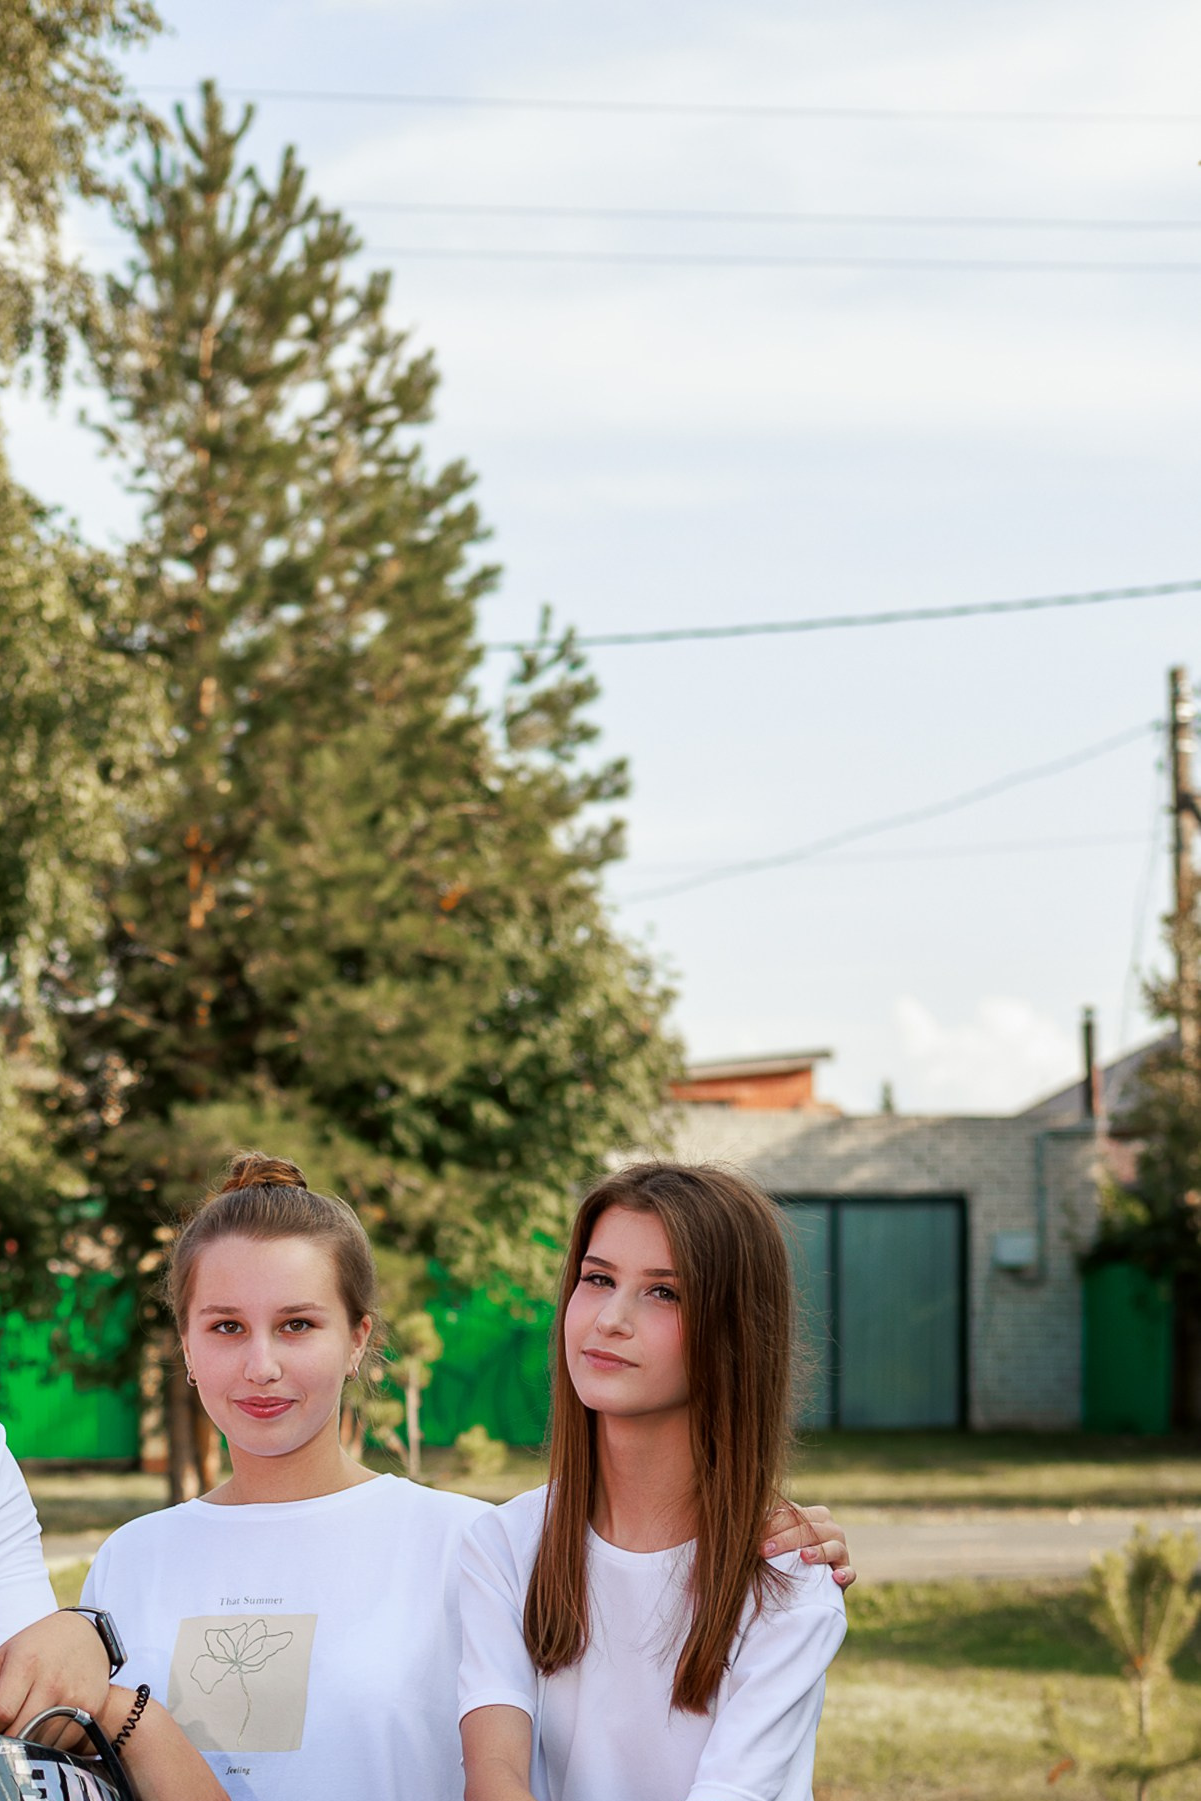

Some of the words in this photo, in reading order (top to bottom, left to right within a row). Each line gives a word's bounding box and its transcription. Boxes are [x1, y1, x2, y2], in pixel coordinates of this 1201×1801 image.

[219, 1596, 240, 1606] That
[243, 1595, 285, 1605] Summer
[226, 1765, 251, 1776] feeling
